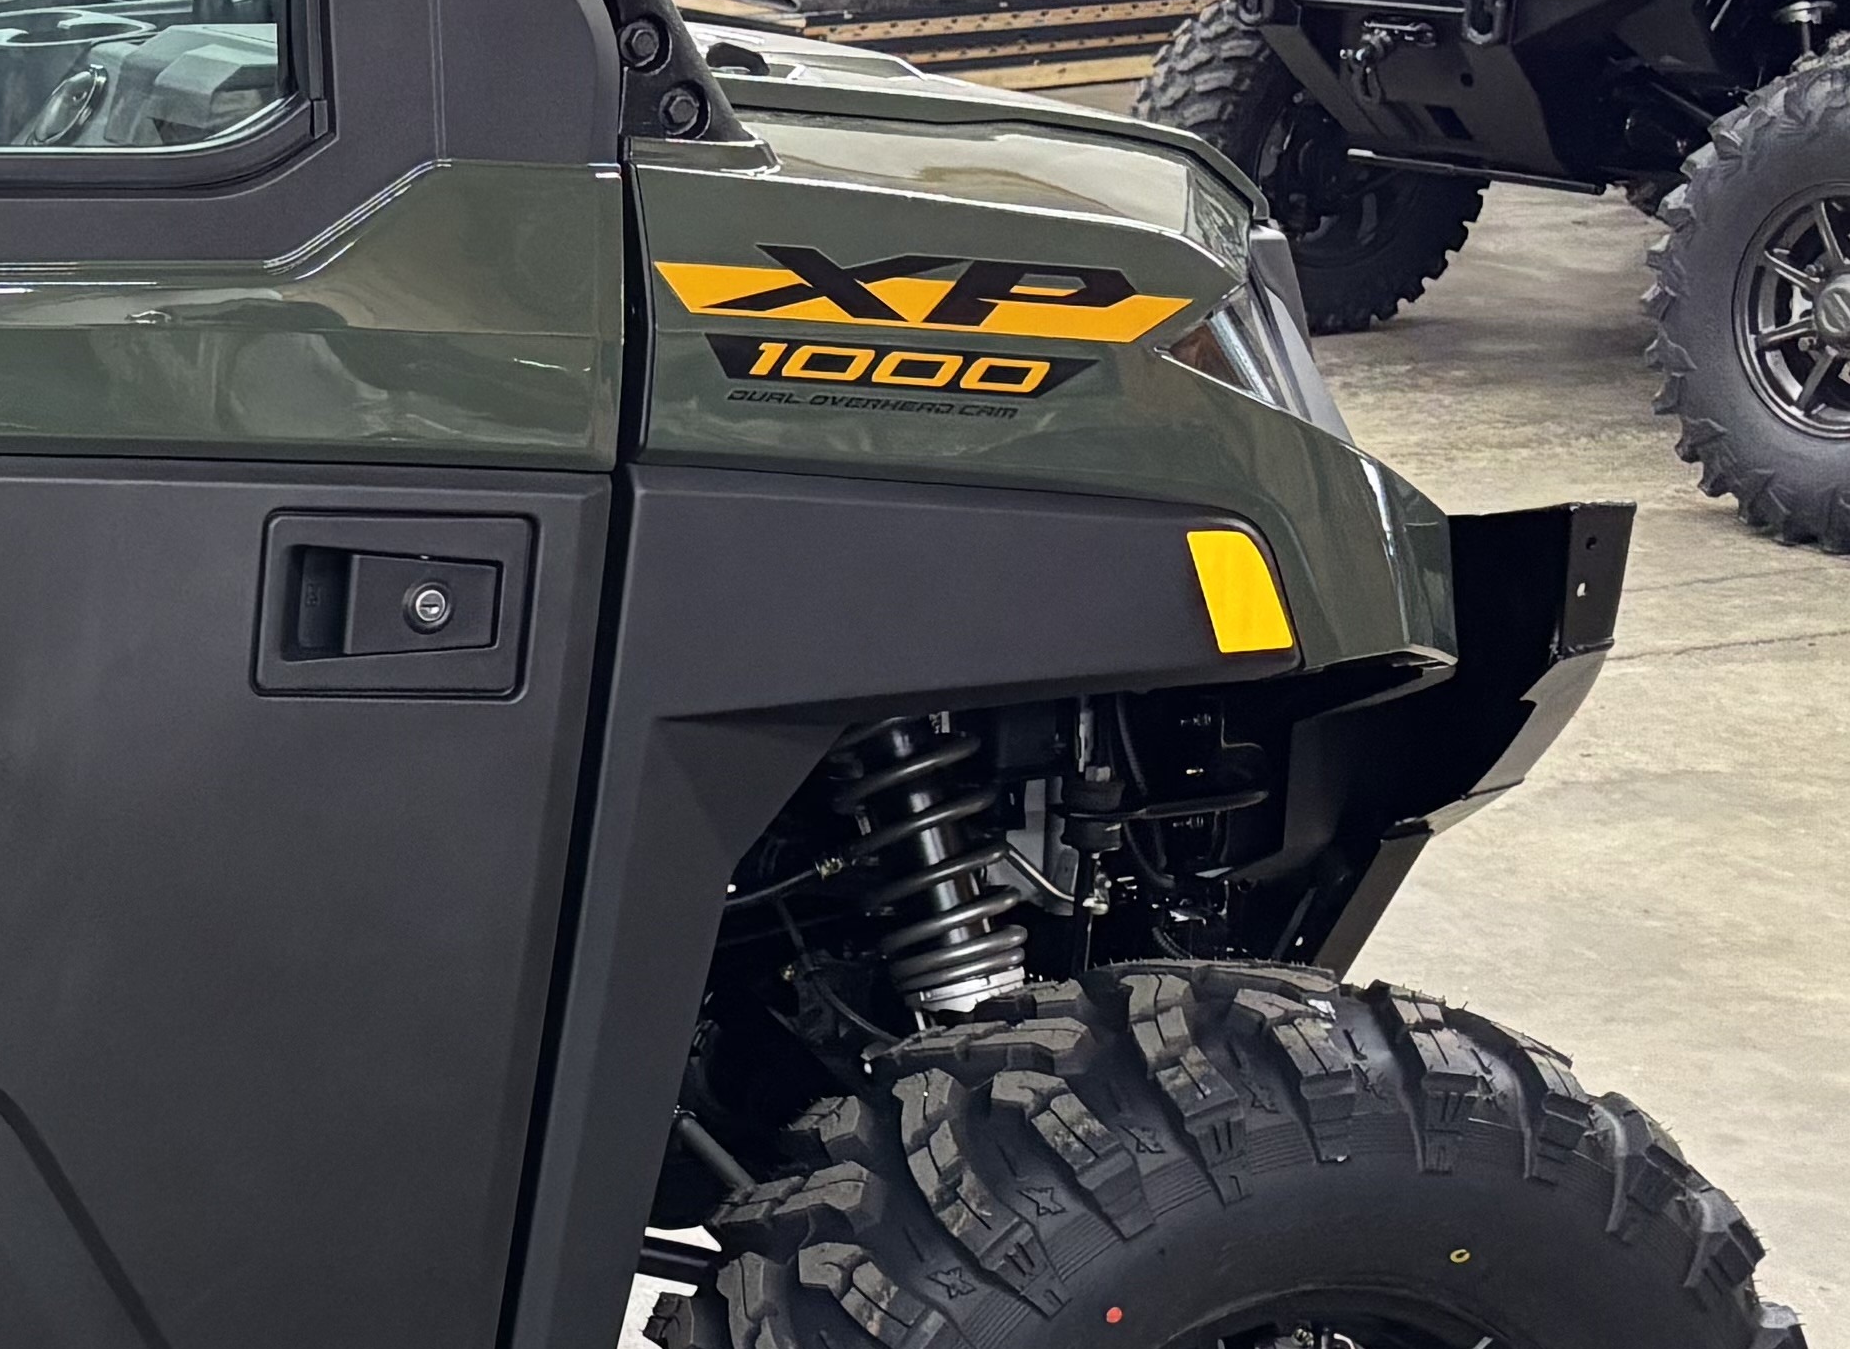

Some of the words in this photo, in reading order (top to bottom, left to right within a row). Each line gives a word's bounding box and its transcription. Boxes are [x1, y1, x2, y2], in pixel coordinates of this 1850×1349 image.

[701, 244, 1138, 328] XP
[749, 342, 1051, 394] 1000
[727, 389, 800, 405] DUAL
[809, 394, 955, 415] OVERHEAD
[958, 404, 1019, 419] CAM
